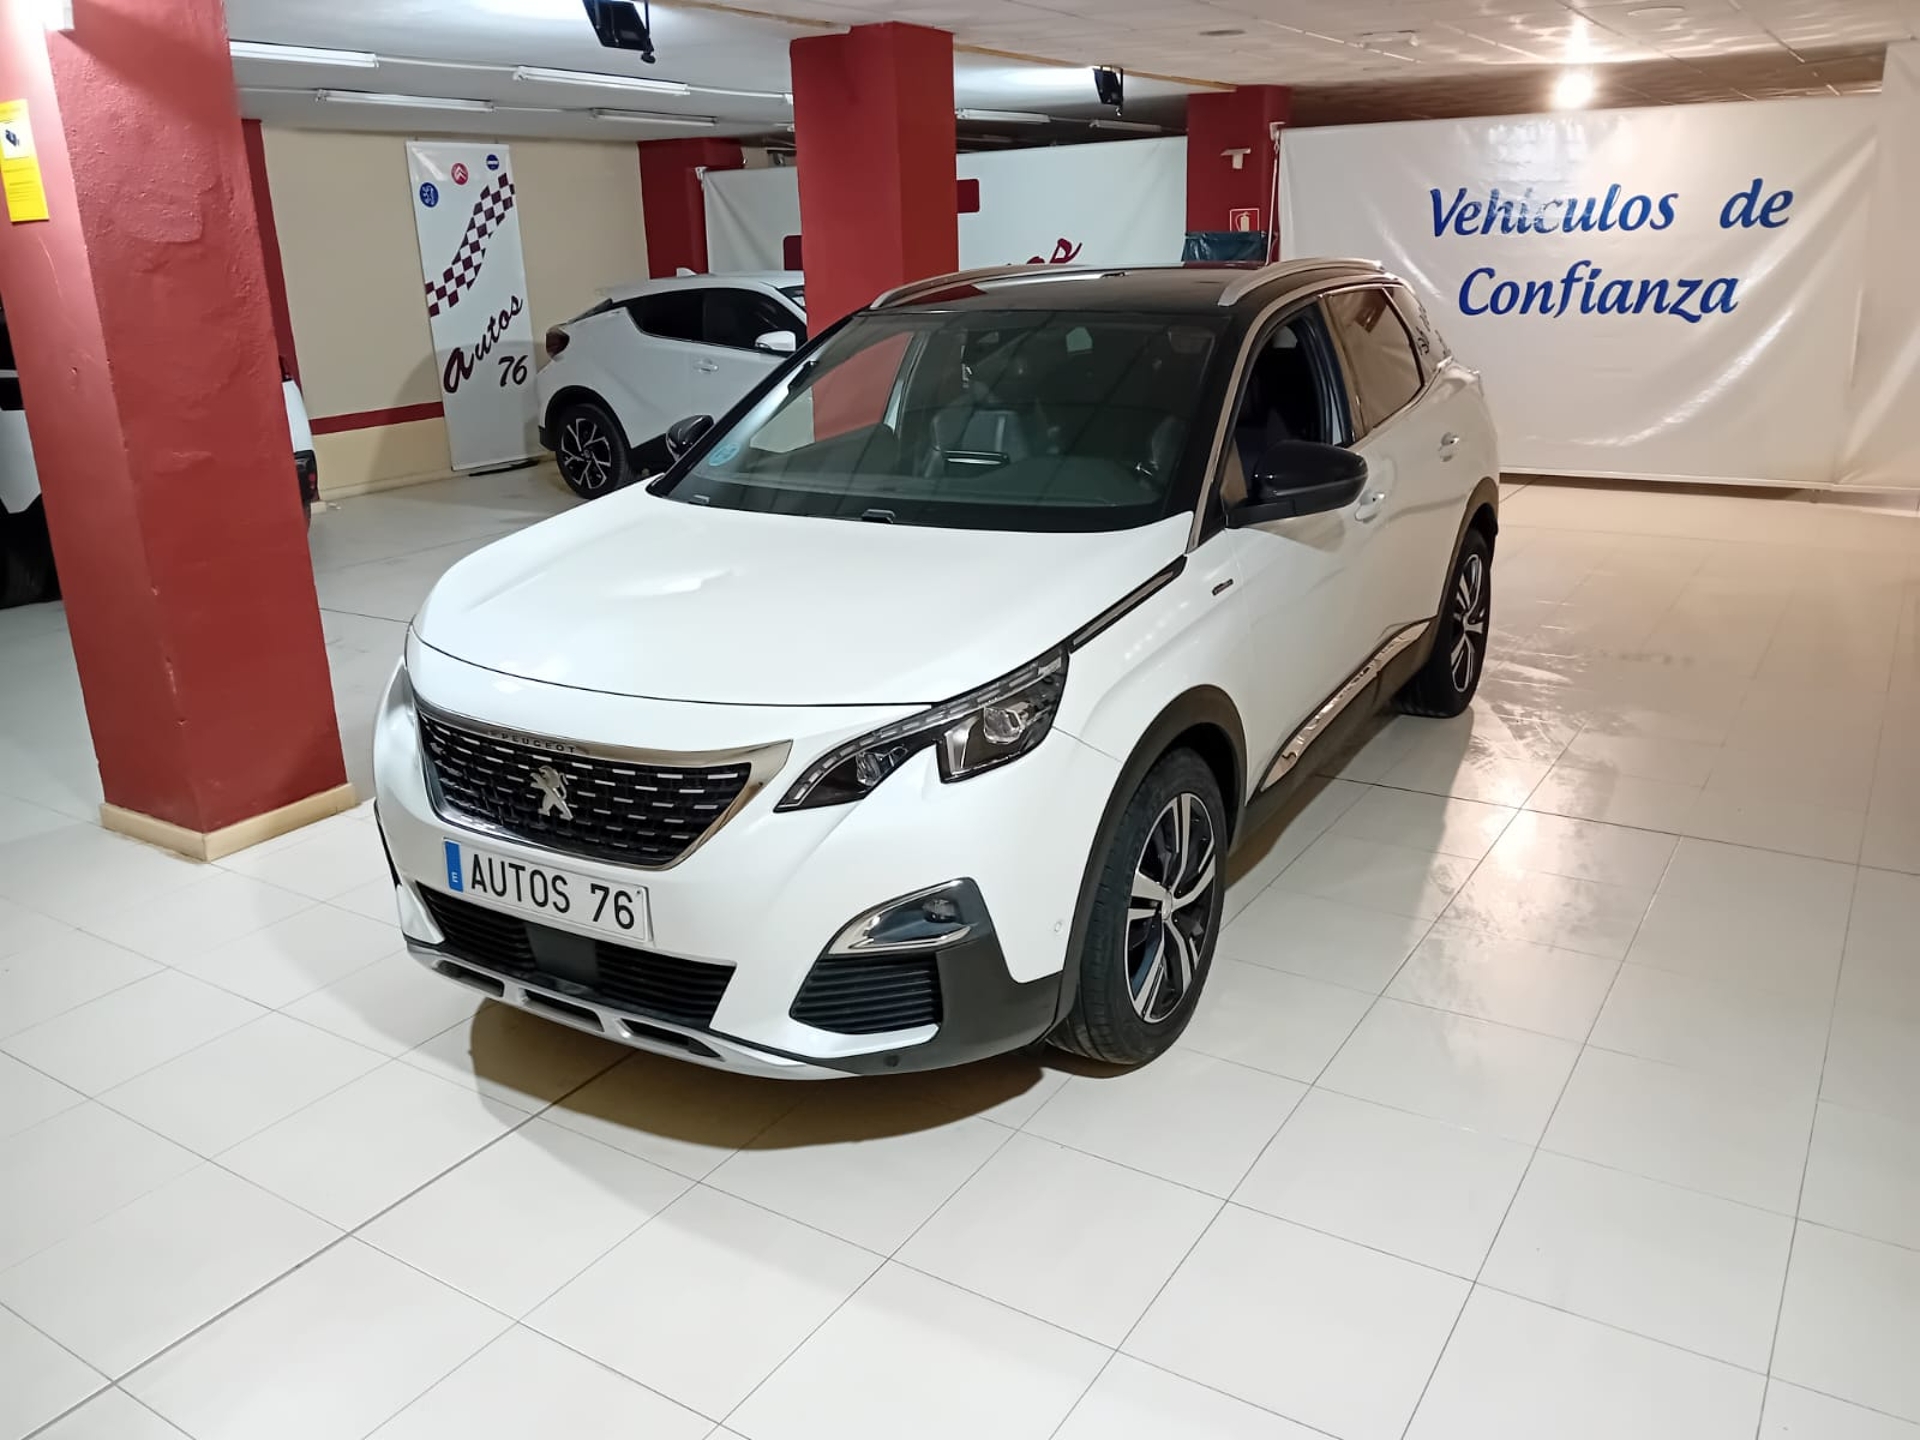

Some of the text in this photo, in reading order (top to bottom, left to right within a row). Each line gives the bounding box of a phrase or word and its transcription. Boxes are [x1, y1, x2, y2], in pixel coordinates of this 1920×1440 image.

[1718, 177, 1794, 229] de
[1458, 259, 1740, 324] Confianza
[497, 354, 529, 388] 76
[501, 732, 576, 754] PEUGEOT
[470, 853, 636, 930] AUTOS 76
